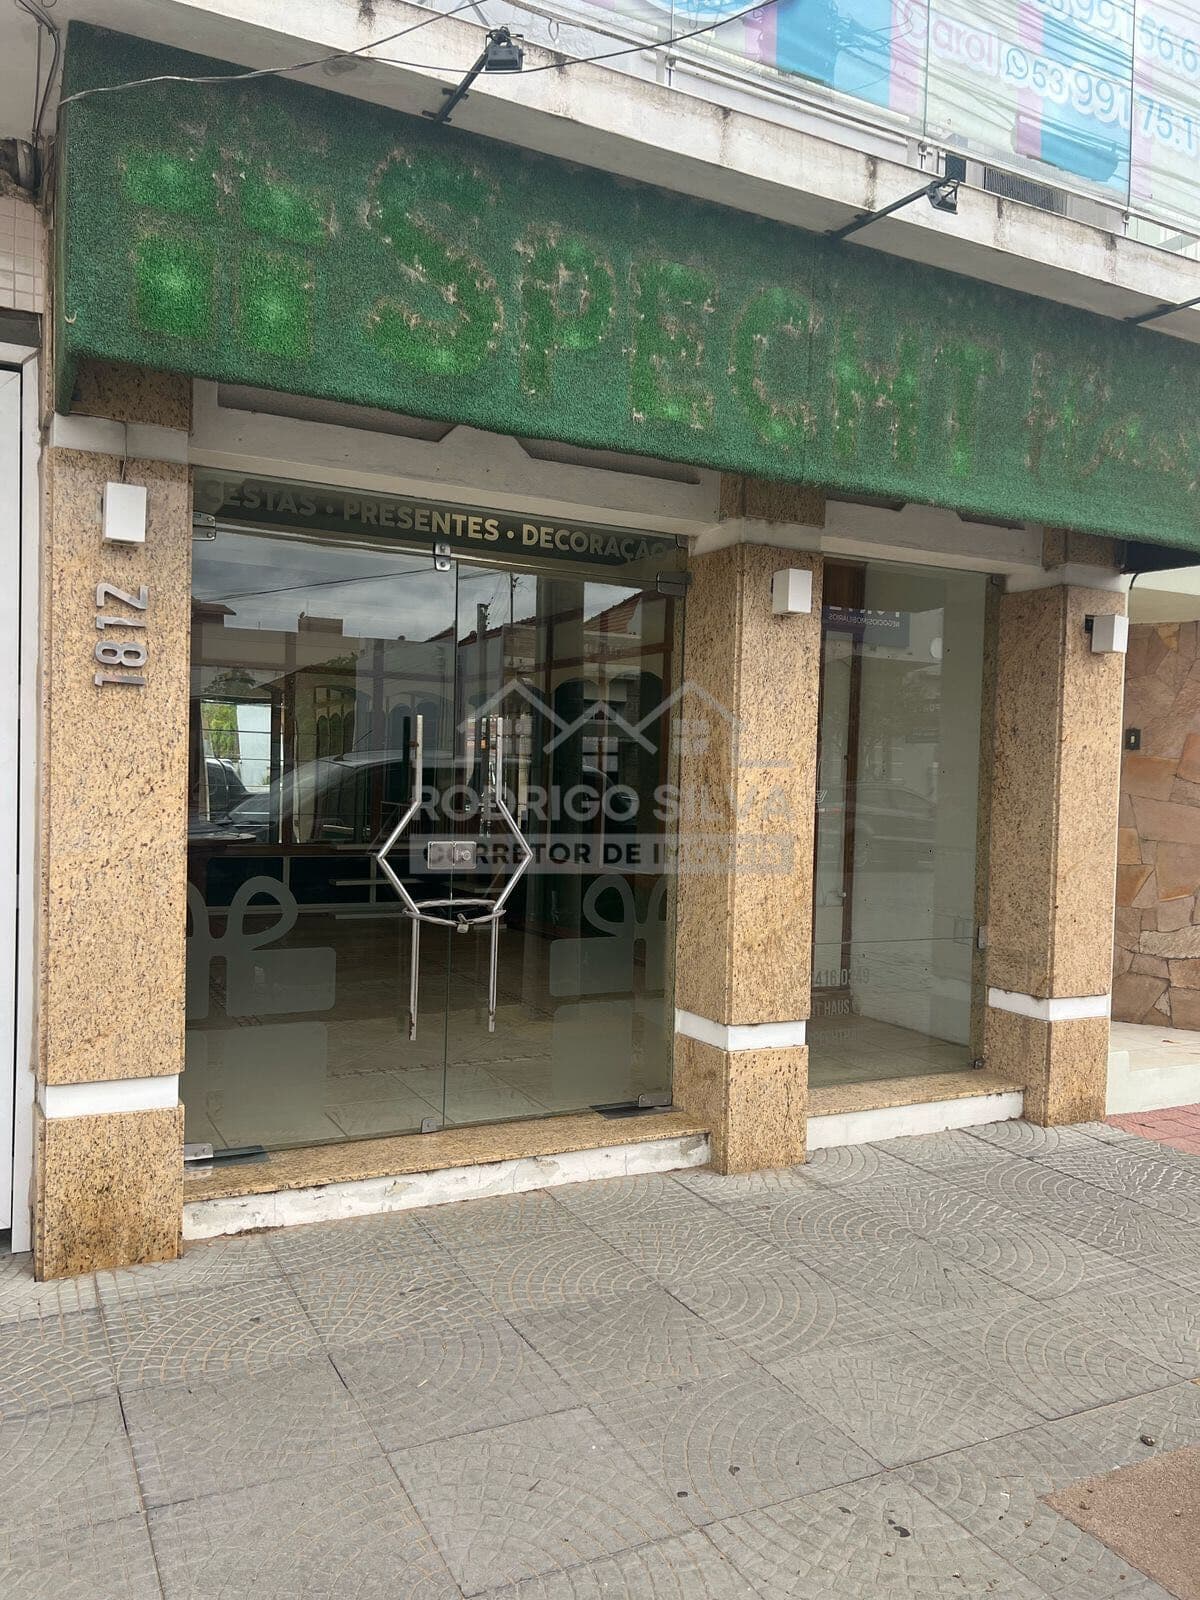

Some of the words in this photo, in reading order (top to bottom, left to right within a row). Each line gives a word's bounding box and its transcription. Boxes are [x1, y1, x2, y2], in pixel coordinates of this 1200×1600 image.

[1032, 58, 1064, 95] 53
[343, 501, 500, 542] PRESENTES
[95, 582, 149, 686] 1817
